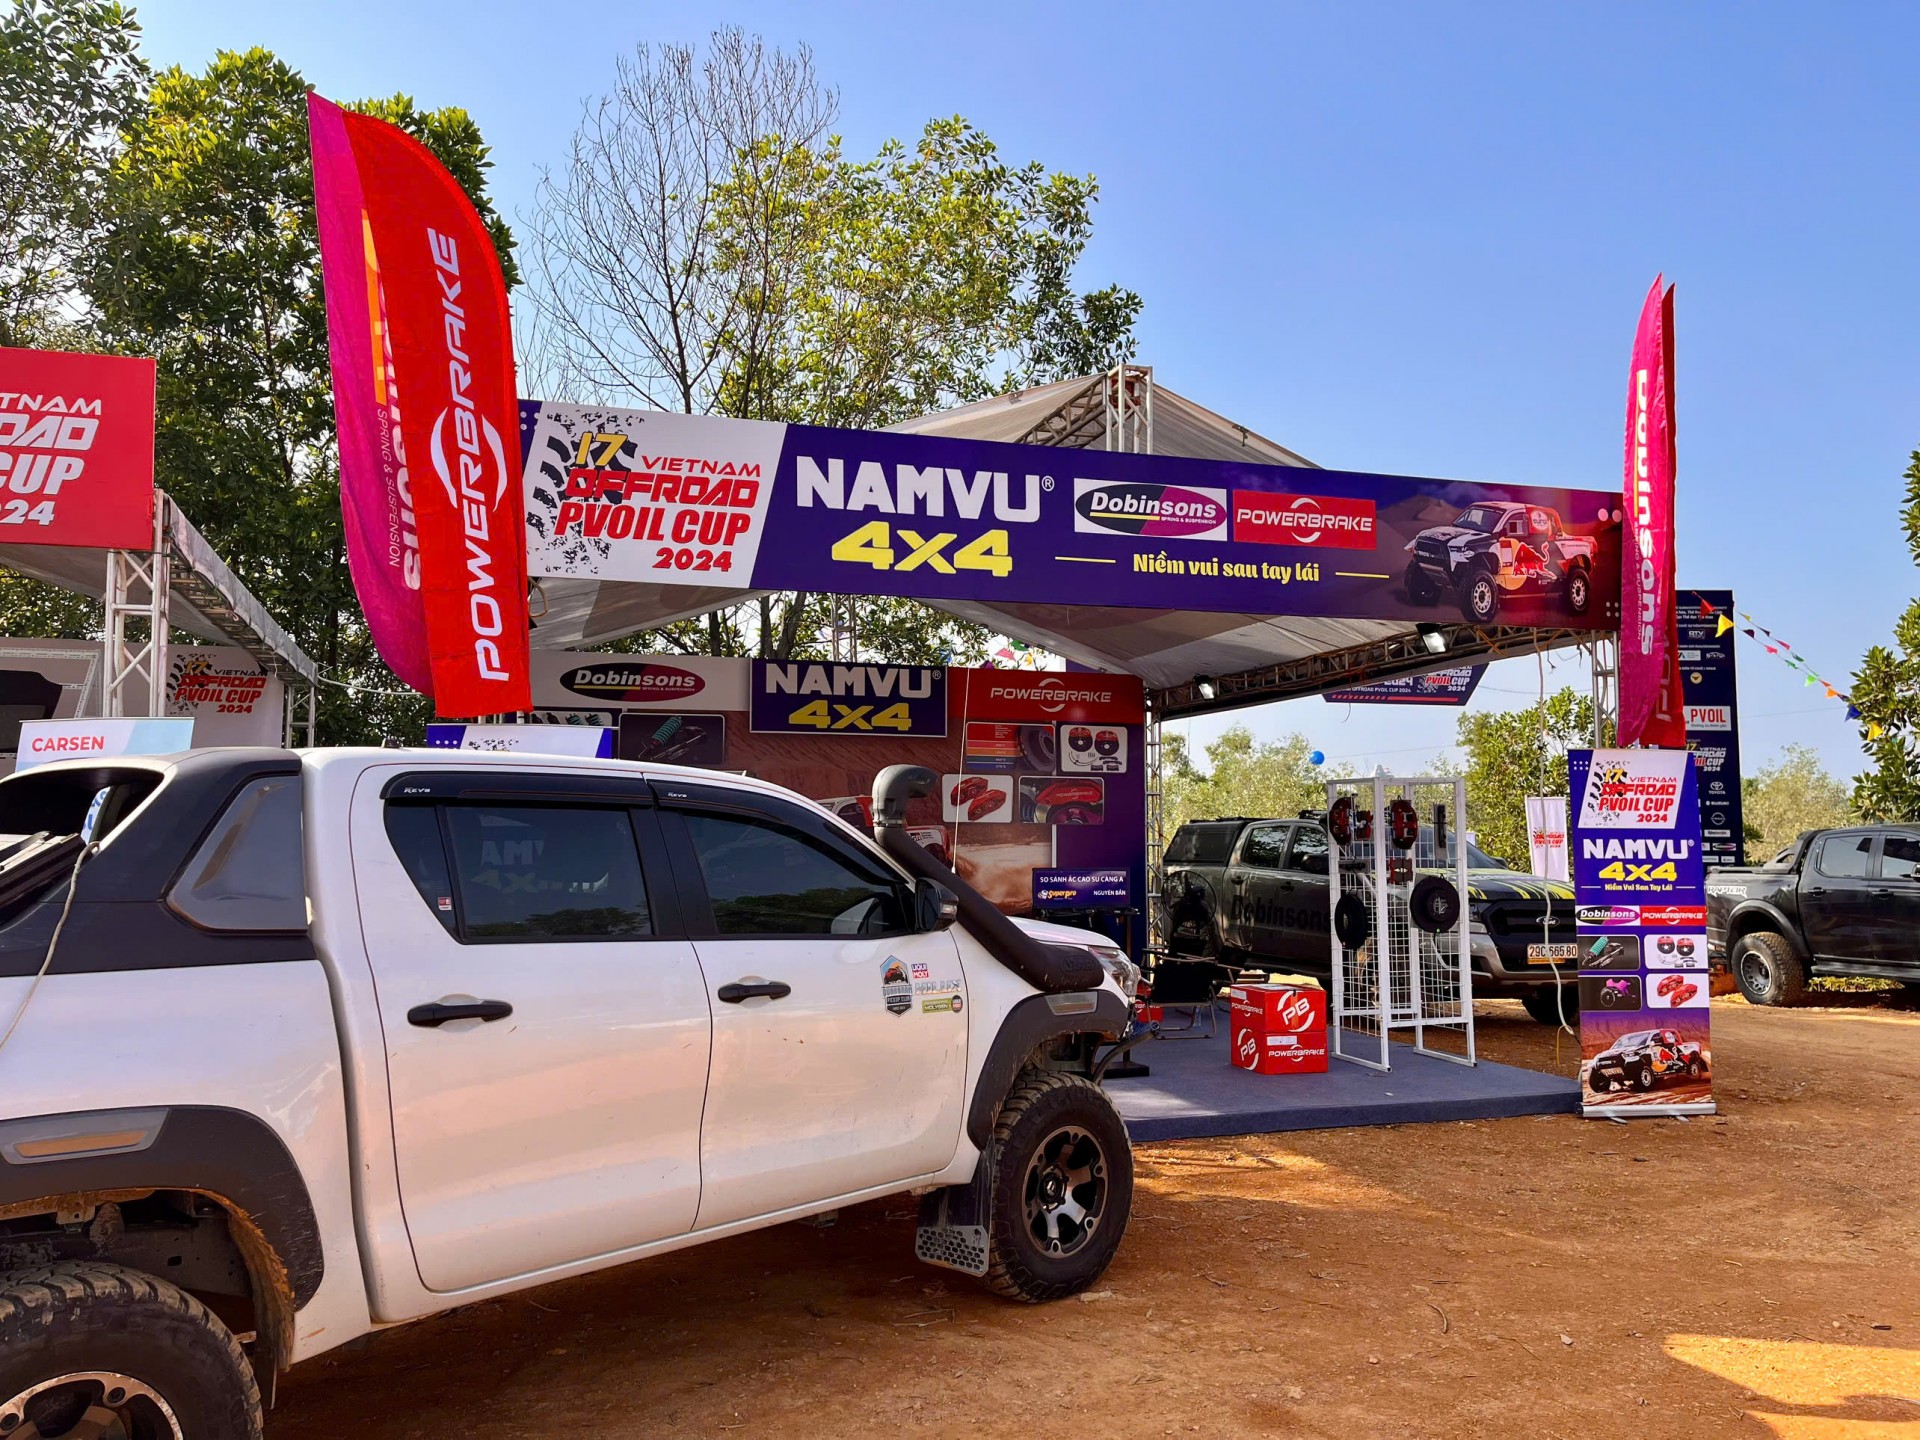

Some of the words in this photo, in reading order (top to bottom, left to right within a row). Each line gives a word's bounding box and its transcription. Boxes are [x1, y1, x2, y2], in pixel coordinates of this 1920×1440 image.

[427, 227, 510, 682] POWERBRAKE
[575, 431, 628, 466] 17
[641, 455, 761, 478] VIETNAM
[376, 408, 392, 462] SPRING
[386, 475, 401, 567] SUSPENSION
[565, 468, 760, 508] OFFROAD
[1090, 491, 1217, 518] Dobinsons
[554, 501, 666, 541] PVOIL
[671, 508, 751, 546] CUP
[1237, 508, 1373, 532] POWERBRAKE
[652, 547, 733, 573] 2024
[1133, 550, 1185, 575] Niềm
[1188, 557, 1220, 577] vui
[1222, 562, 1259, 578] sau
[1261, 562, 1292, 585] tay
[1295, 561, 1320, 582] lái
[214, 668, 267, 677] VIETNAM
[573, 669, 696, 688] Dobinsons
[179, 674, 267, 689] OFFROAD
[1425, 676, 1451, 686] PVOIL
[1451, 677, 1470, 686] CUP
[175, 688, 224, 703] PVOIL
[225, 689, 262, 704] CUP
[990, 687, 1112, 703] POWERBRAKE
[216, 704, 253, 714] 2024
[1691, 708, 1727, 723] PVOIL
[31, 735, 105, 753] CARSEN
[1604, 768, 1625, 783] 17
[1601, 784, 1677, 796] OFFROAD
[1598, 797, 1641, 812] PVOIL
[1643, 798, 1674, 812] CUP
[1636, 814, 1668, 823] 2024
[1580, 909, 1635, 919] Dobinsons
[1642, 911, 1704, 920] POWERBRAKE
[1231, 1002, 1263, 1015] POWERBRAKE
[1282, 997, 1310, 1025] PB
[1240, 1038, 1256, 1061] PB
[1268, 1048, 1325, 1057] POWERBRAKE
